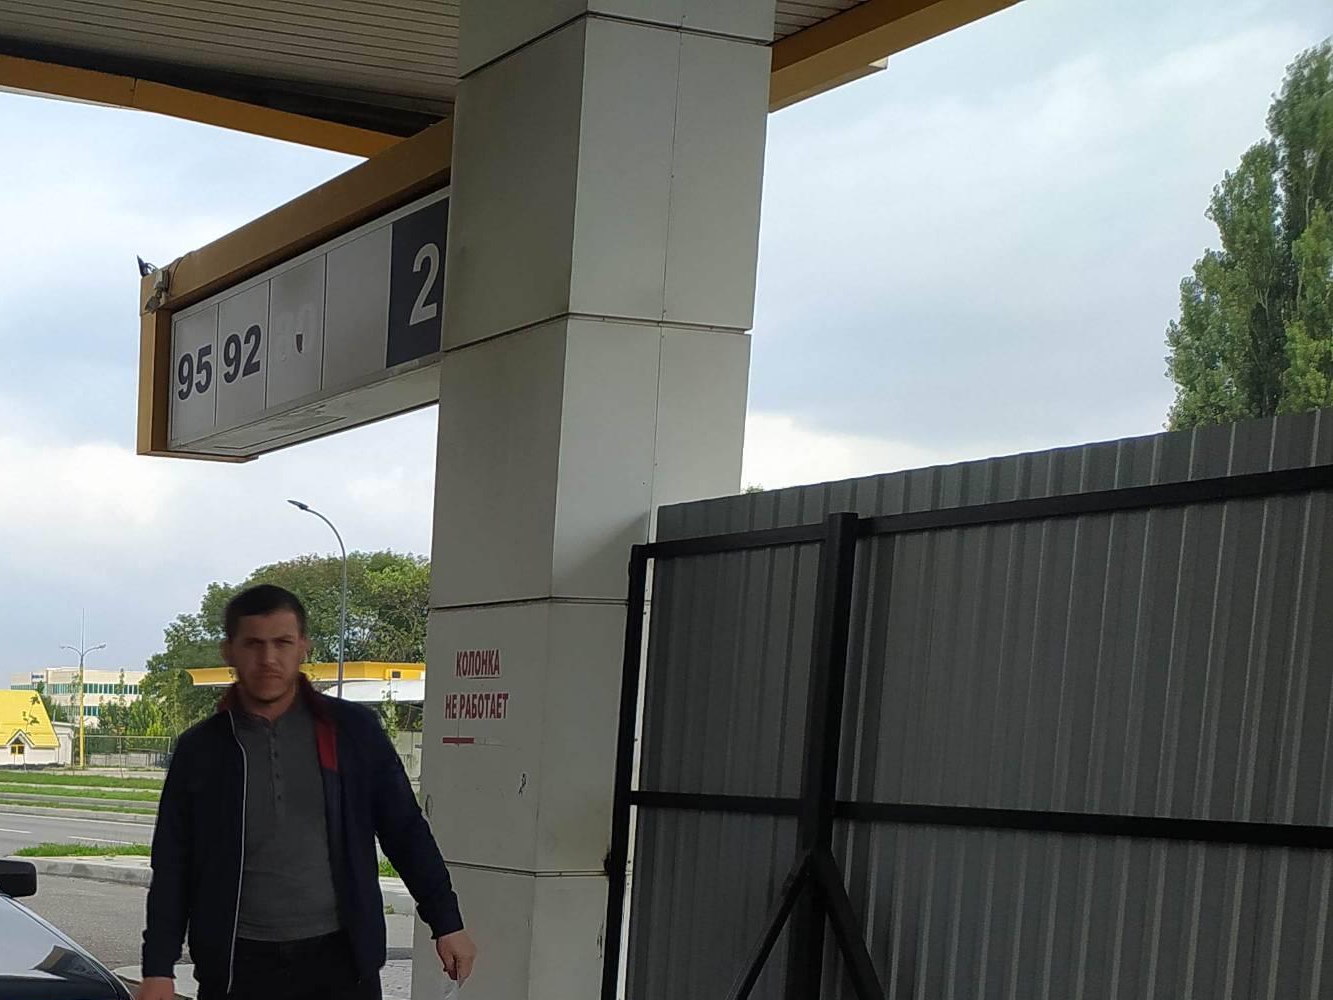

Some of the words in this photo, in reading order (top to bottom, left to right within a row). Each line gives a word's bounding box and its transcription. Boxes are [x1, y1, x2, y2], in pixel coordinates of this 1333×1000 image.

[409, 243, 441, 327] 2
[177, 344, 213, 401] 95
[222, 324, 262, 385] 92
[456, 650, 501, 677] КОЛОНКА
[445, 694, 457, 719] НЕ
[459, 693, 509, 719] РАБОТАЕТ
